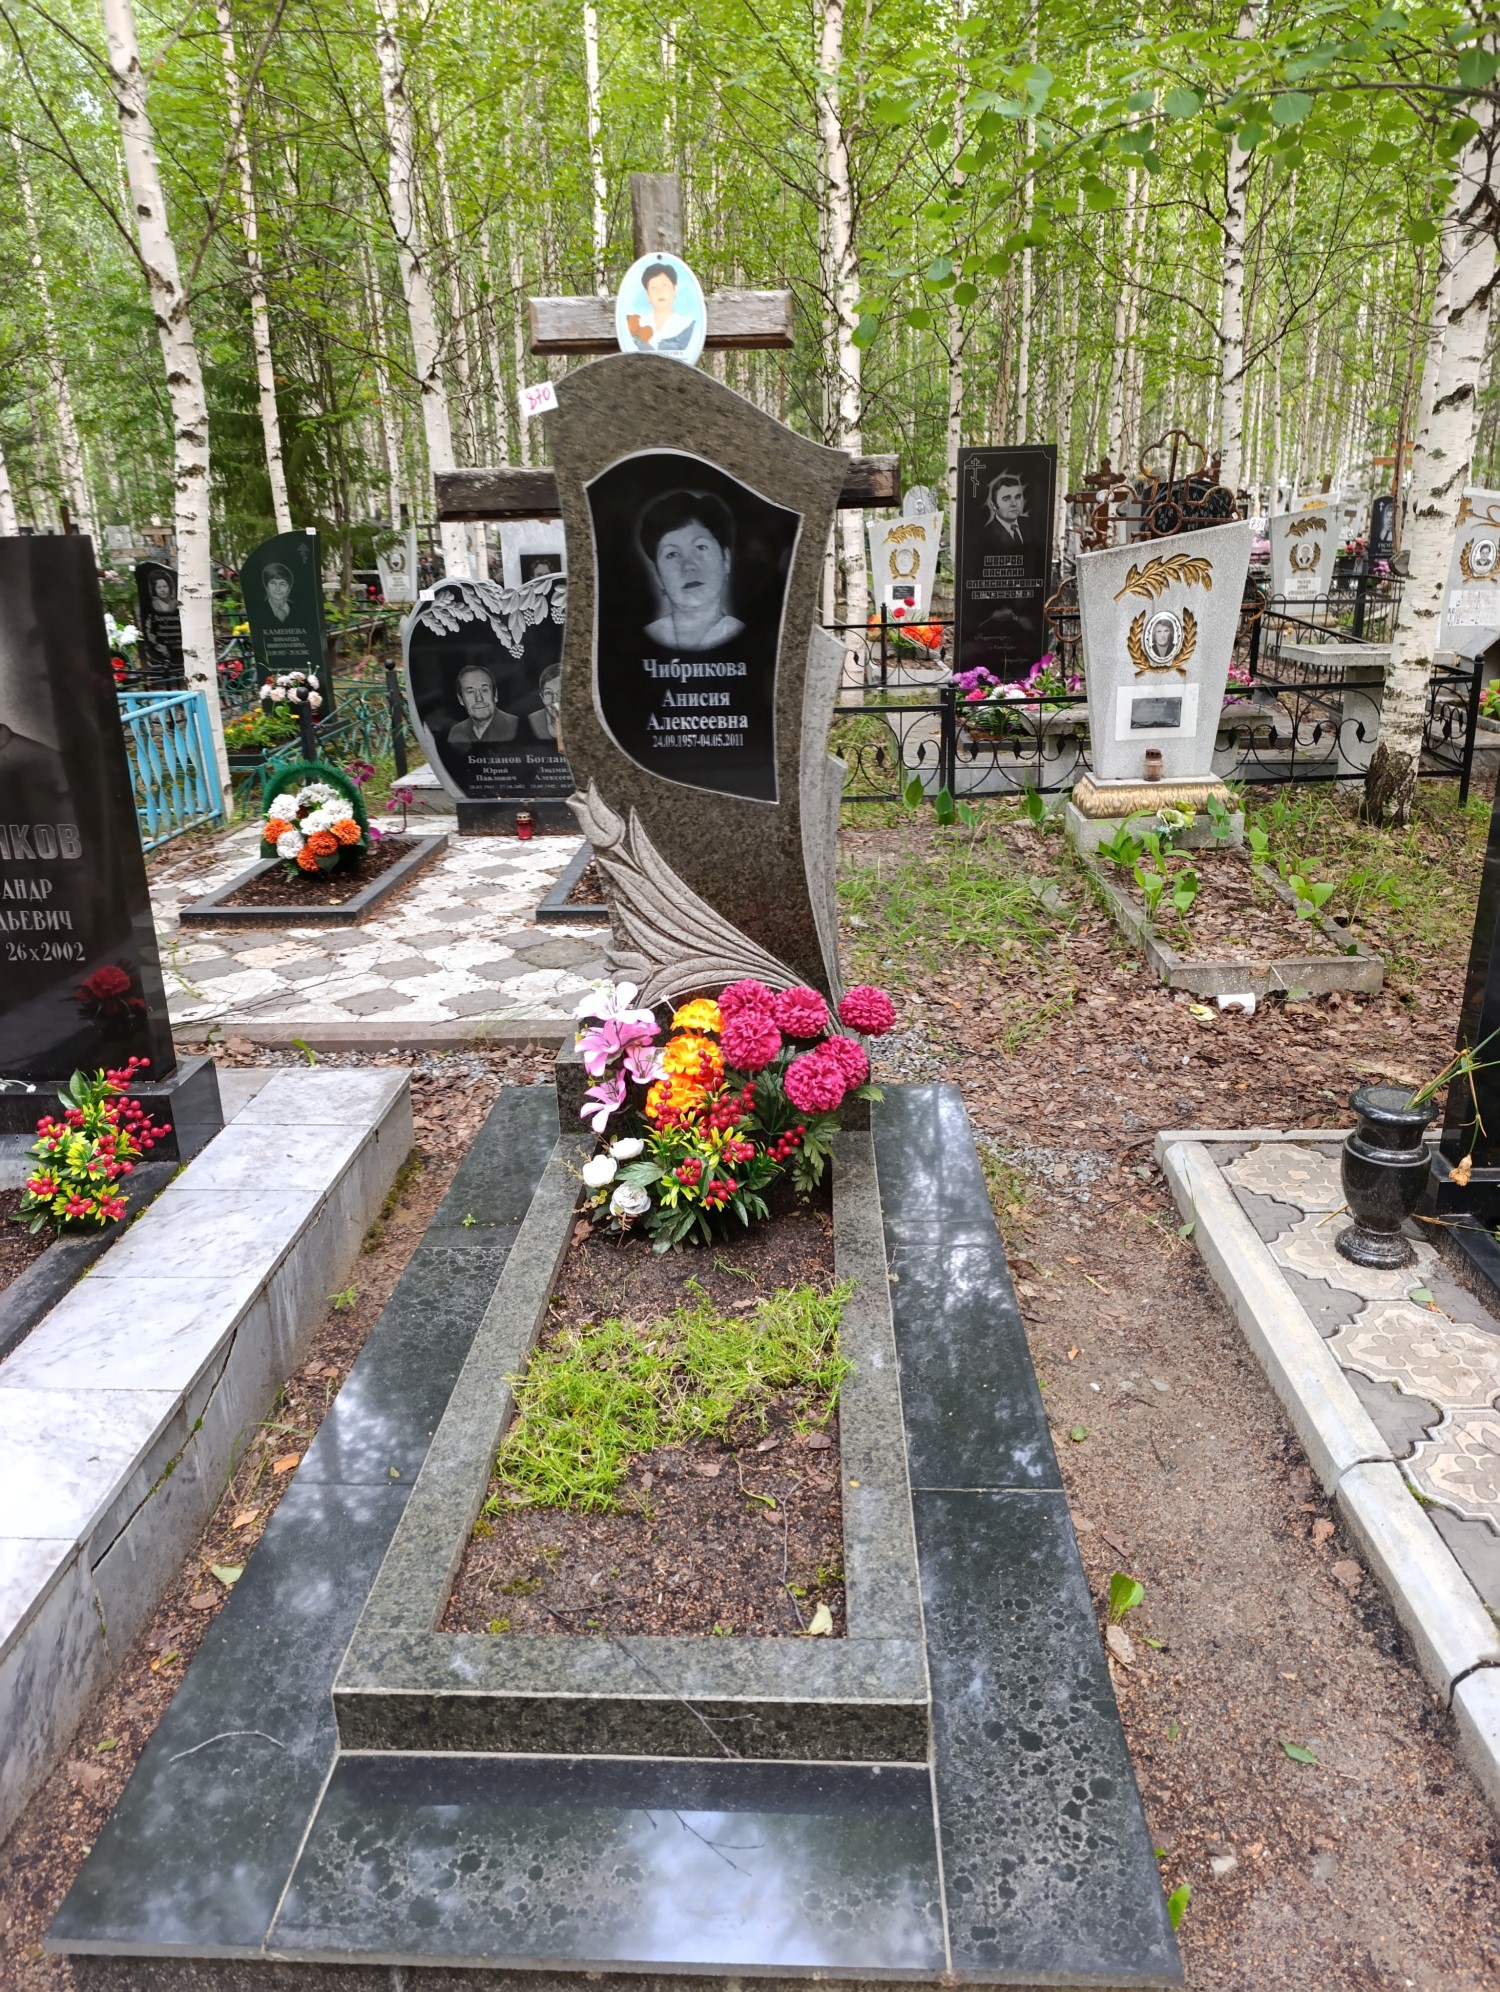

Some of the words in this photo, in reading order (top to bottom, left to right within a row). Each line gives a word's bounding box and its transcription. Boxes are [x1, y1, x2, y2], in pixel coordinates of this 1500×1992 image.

[965, 579, 1044, 589] АЛЕКСАНДРОВИЧ
[262, 628, 307, 636] КАМЕНЕВА
[642, 658, 748, 683] Чибрикова
[661, 689, 731, 707] Анисия
[646, 713, 749, 730] Алексеевна
[467, 755, 522, 765] Богданов
[482, 767, 509, 775] Юрий
[0, 878, 53, 903] АНДР
